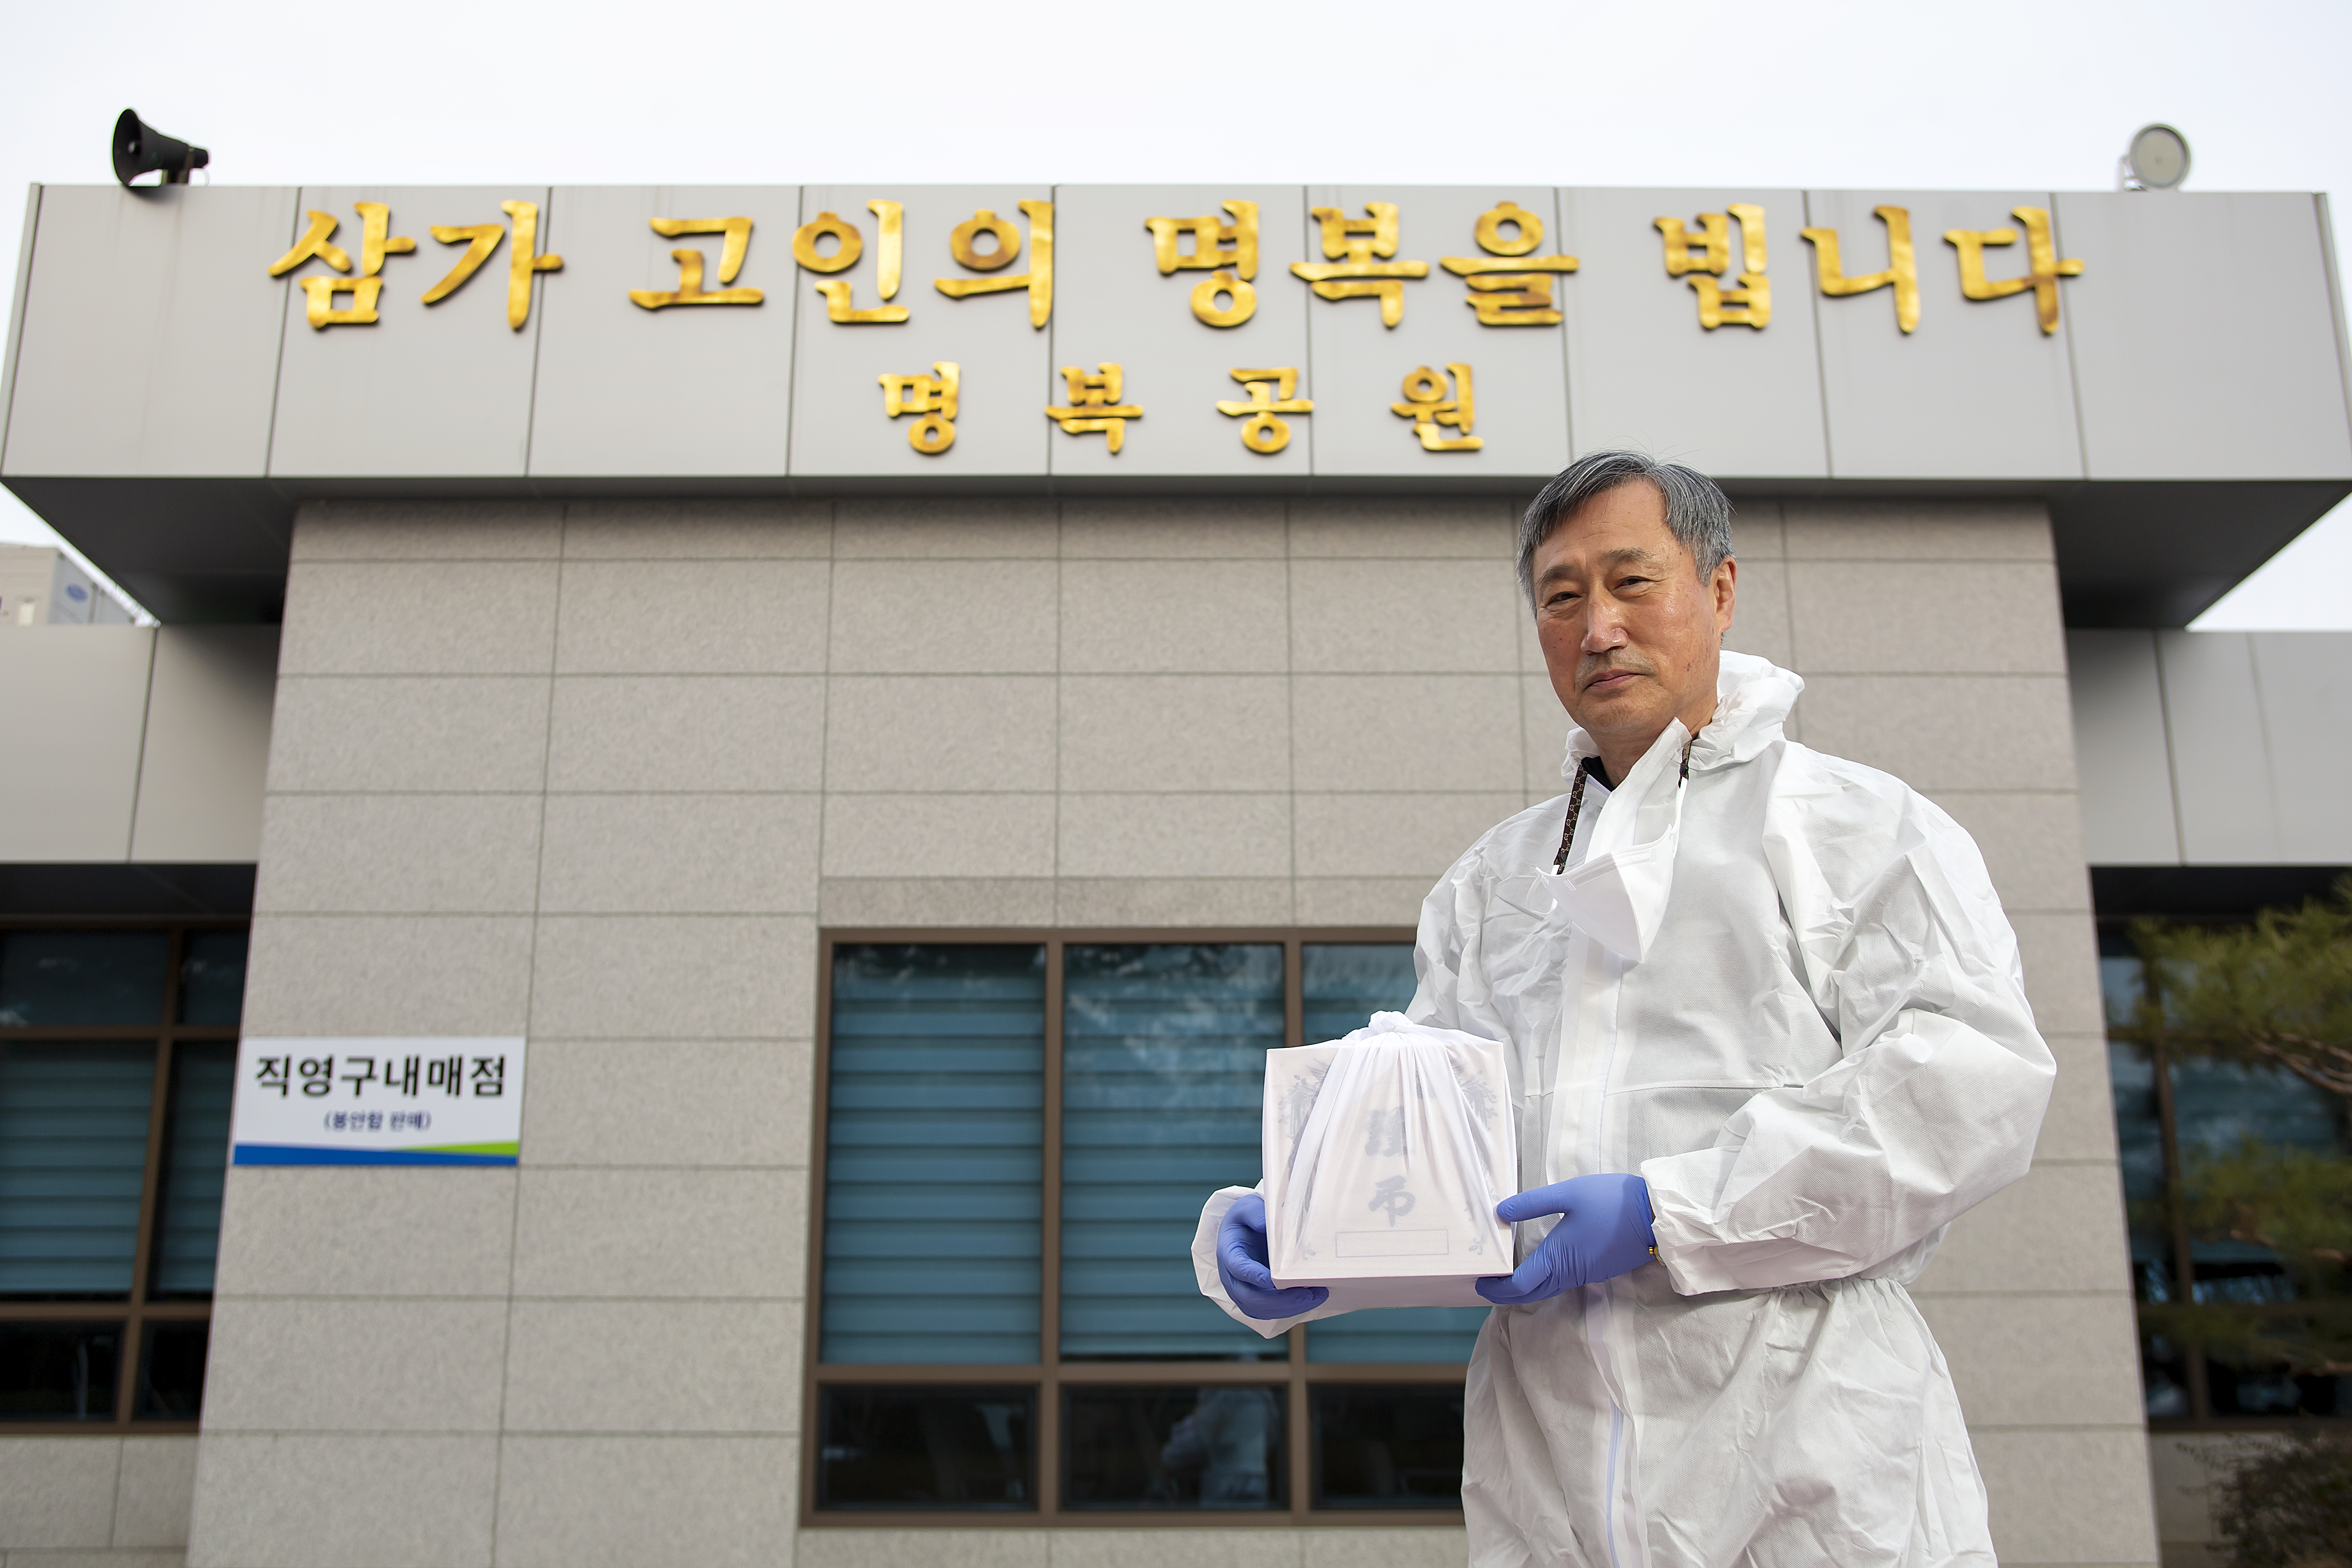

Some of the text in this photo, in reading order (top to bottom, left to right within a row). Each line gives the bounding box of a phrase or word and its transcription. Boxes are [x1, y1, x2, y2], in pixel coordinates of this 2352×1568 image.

[268, 200, 2084, 335] 삼가 고인의 명복을 빕니다
[879, 363, 1482, 455] 명복공원
[256, 1054, 506, 1097] 직영구내매점
